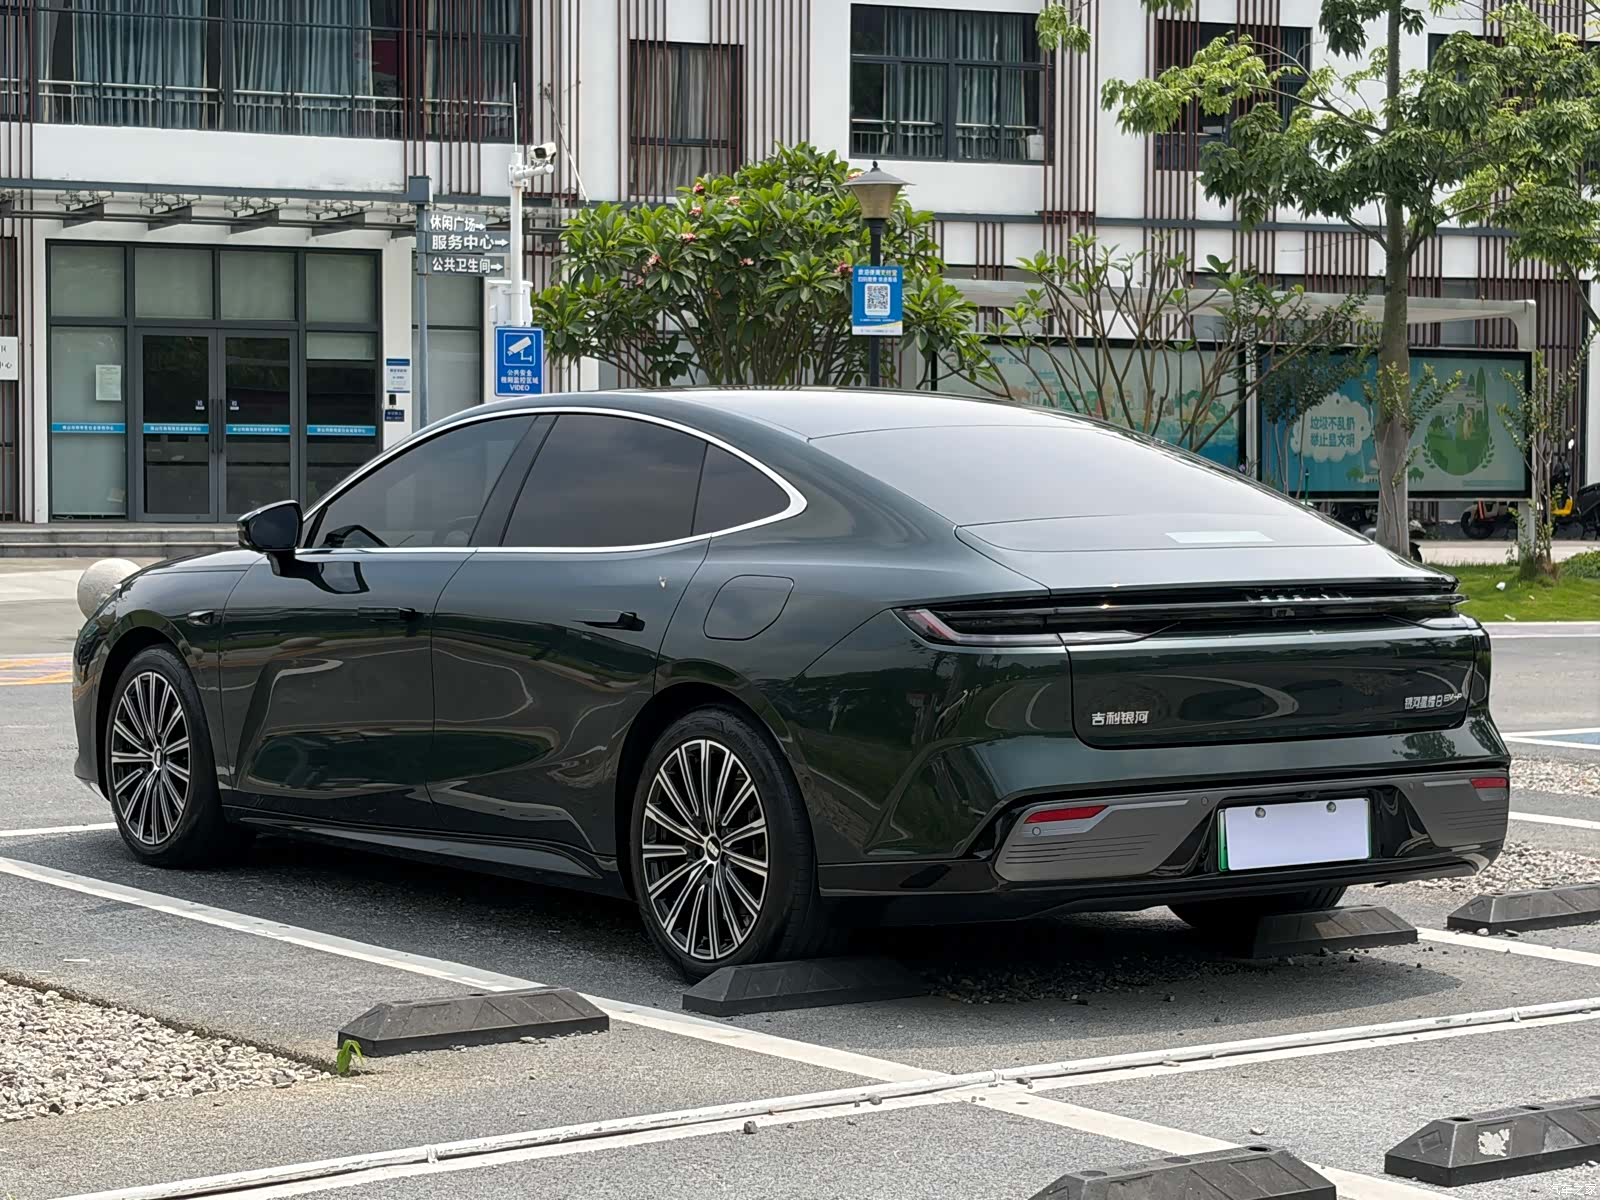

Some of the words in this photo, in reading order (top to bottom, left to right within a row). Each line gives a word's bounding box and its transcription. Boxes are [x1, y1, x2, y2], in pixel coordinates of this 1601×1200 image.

[430, 214, 476, 232] 休闲广场
[432, 234, 494, 251] 服务中心
[432, 257, 491, 274] 公共卫生间
[507, 369, 532, 377] 公共安全
[1091, 710, 1150, 725] 吉利银河
